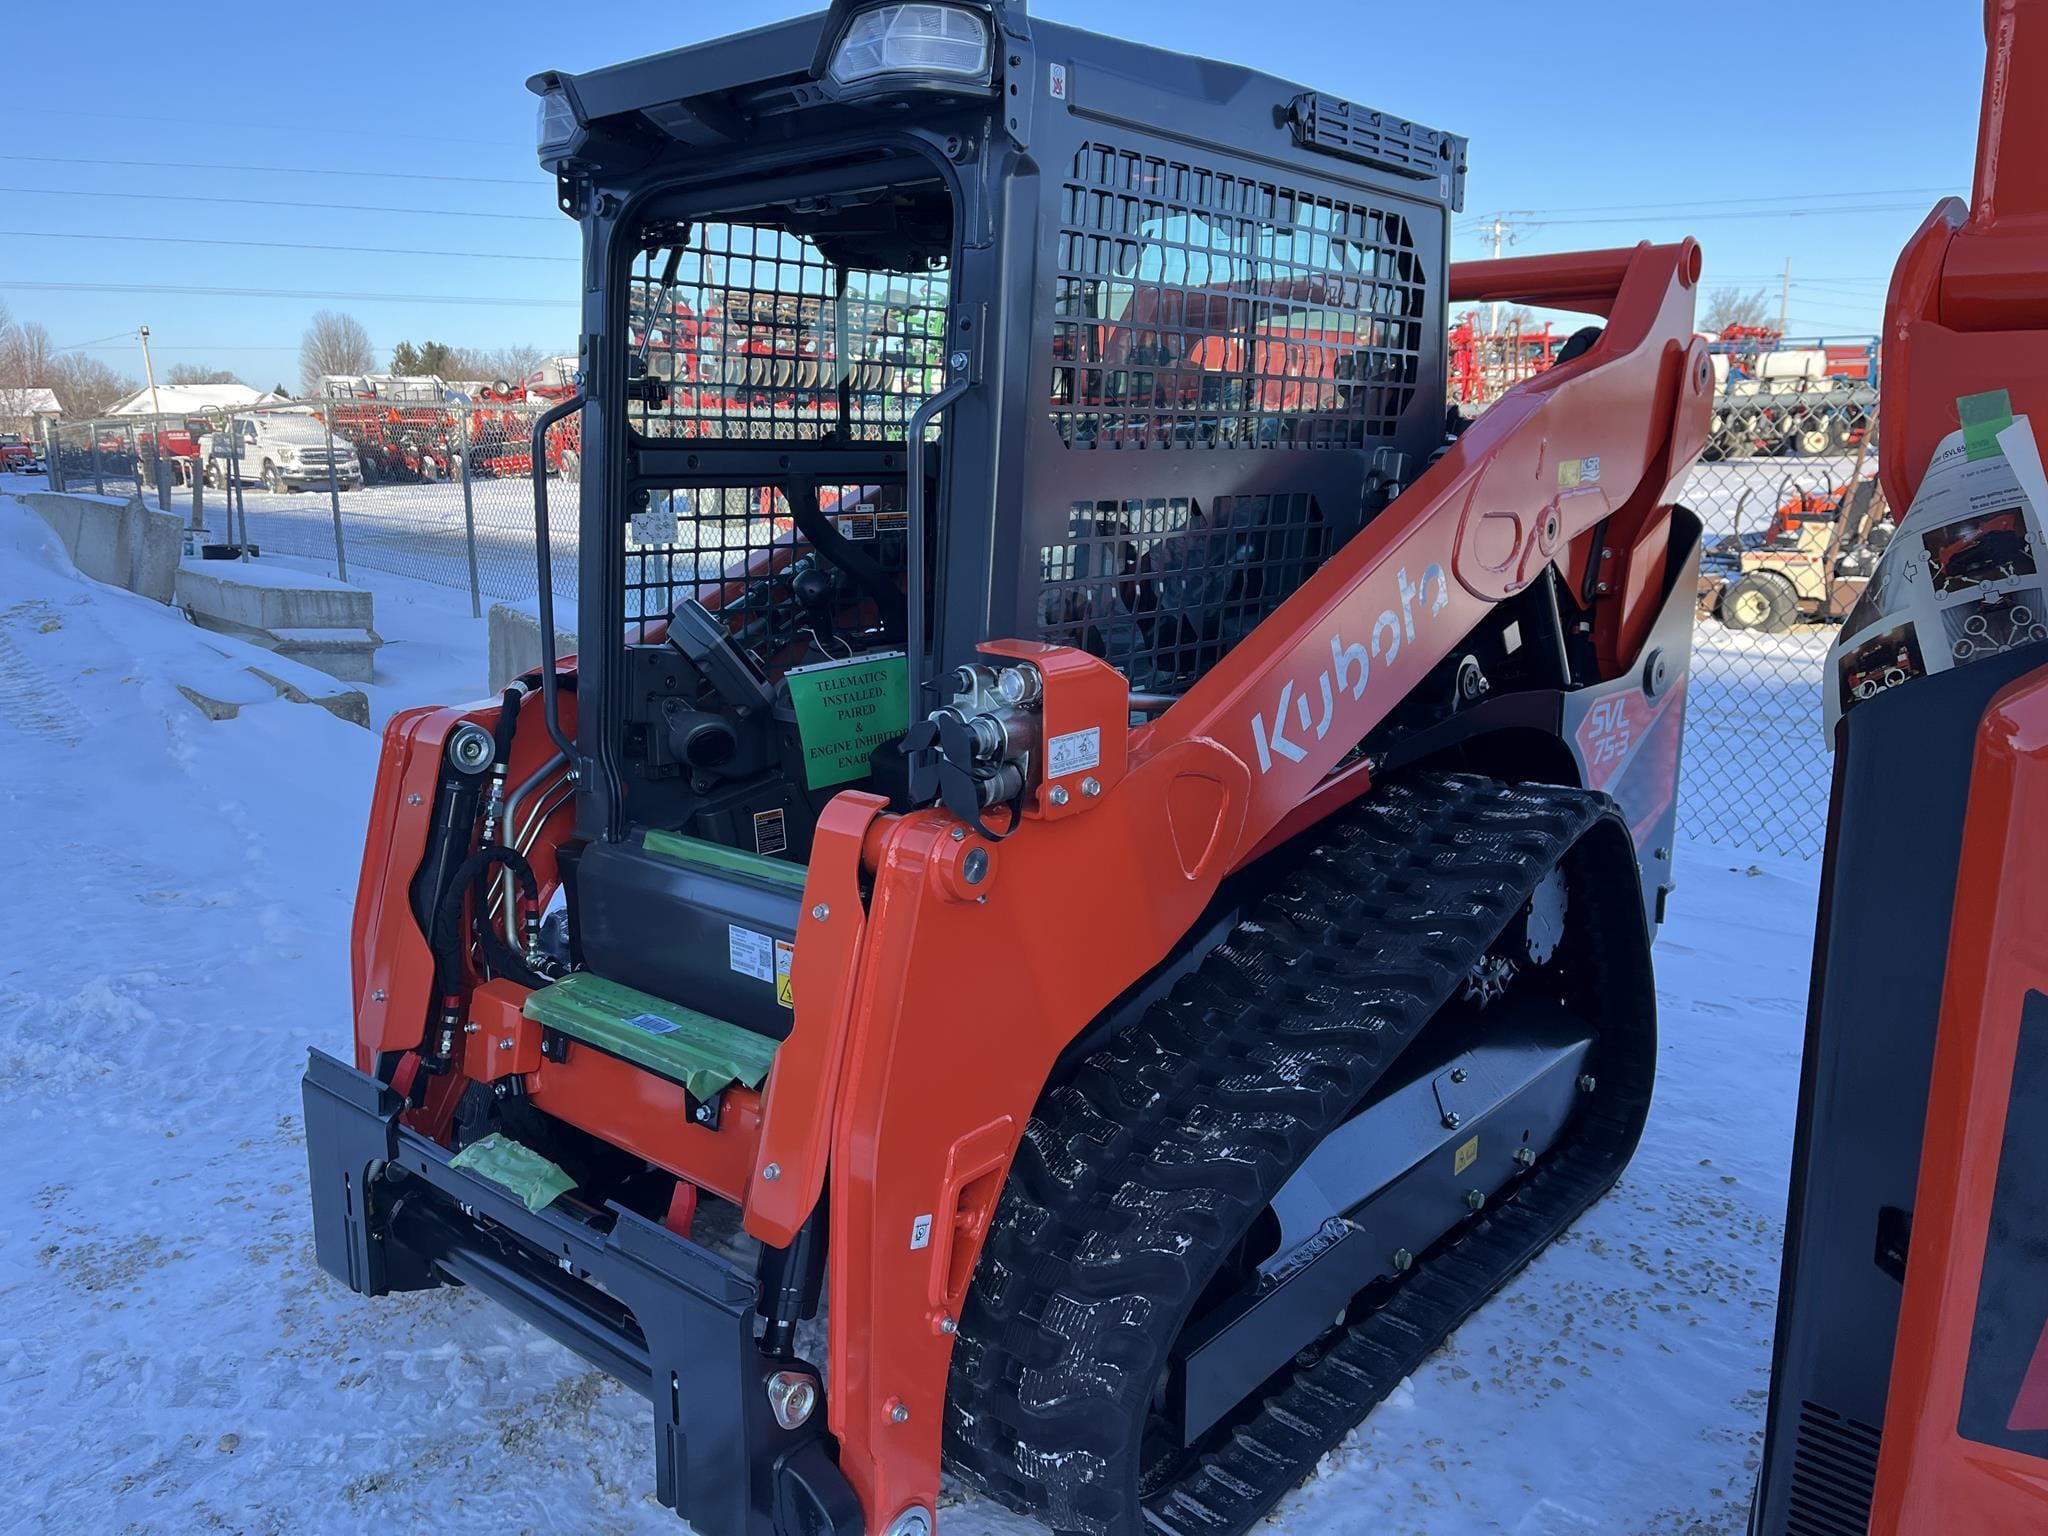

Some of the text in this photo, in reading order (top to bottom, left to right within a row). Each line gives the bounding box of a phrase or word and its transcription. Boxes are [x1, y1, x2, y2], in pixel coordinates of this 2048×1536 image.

[1251, 563, 1449, 775] Kubota
[816, 670, 887, 692] TELEMATICS
[823, 687, 886, 708] INSTALLED,
[837, 703, 876, 720] PAIRED
[1588, 698, 1630, 738] SVL
[855, 722, 863, 733] &
[809, 740, 852, 760] ENGINE
[1594, 731, 1630, 765] 75-3
[838, 751, 870, 769] ENAB
